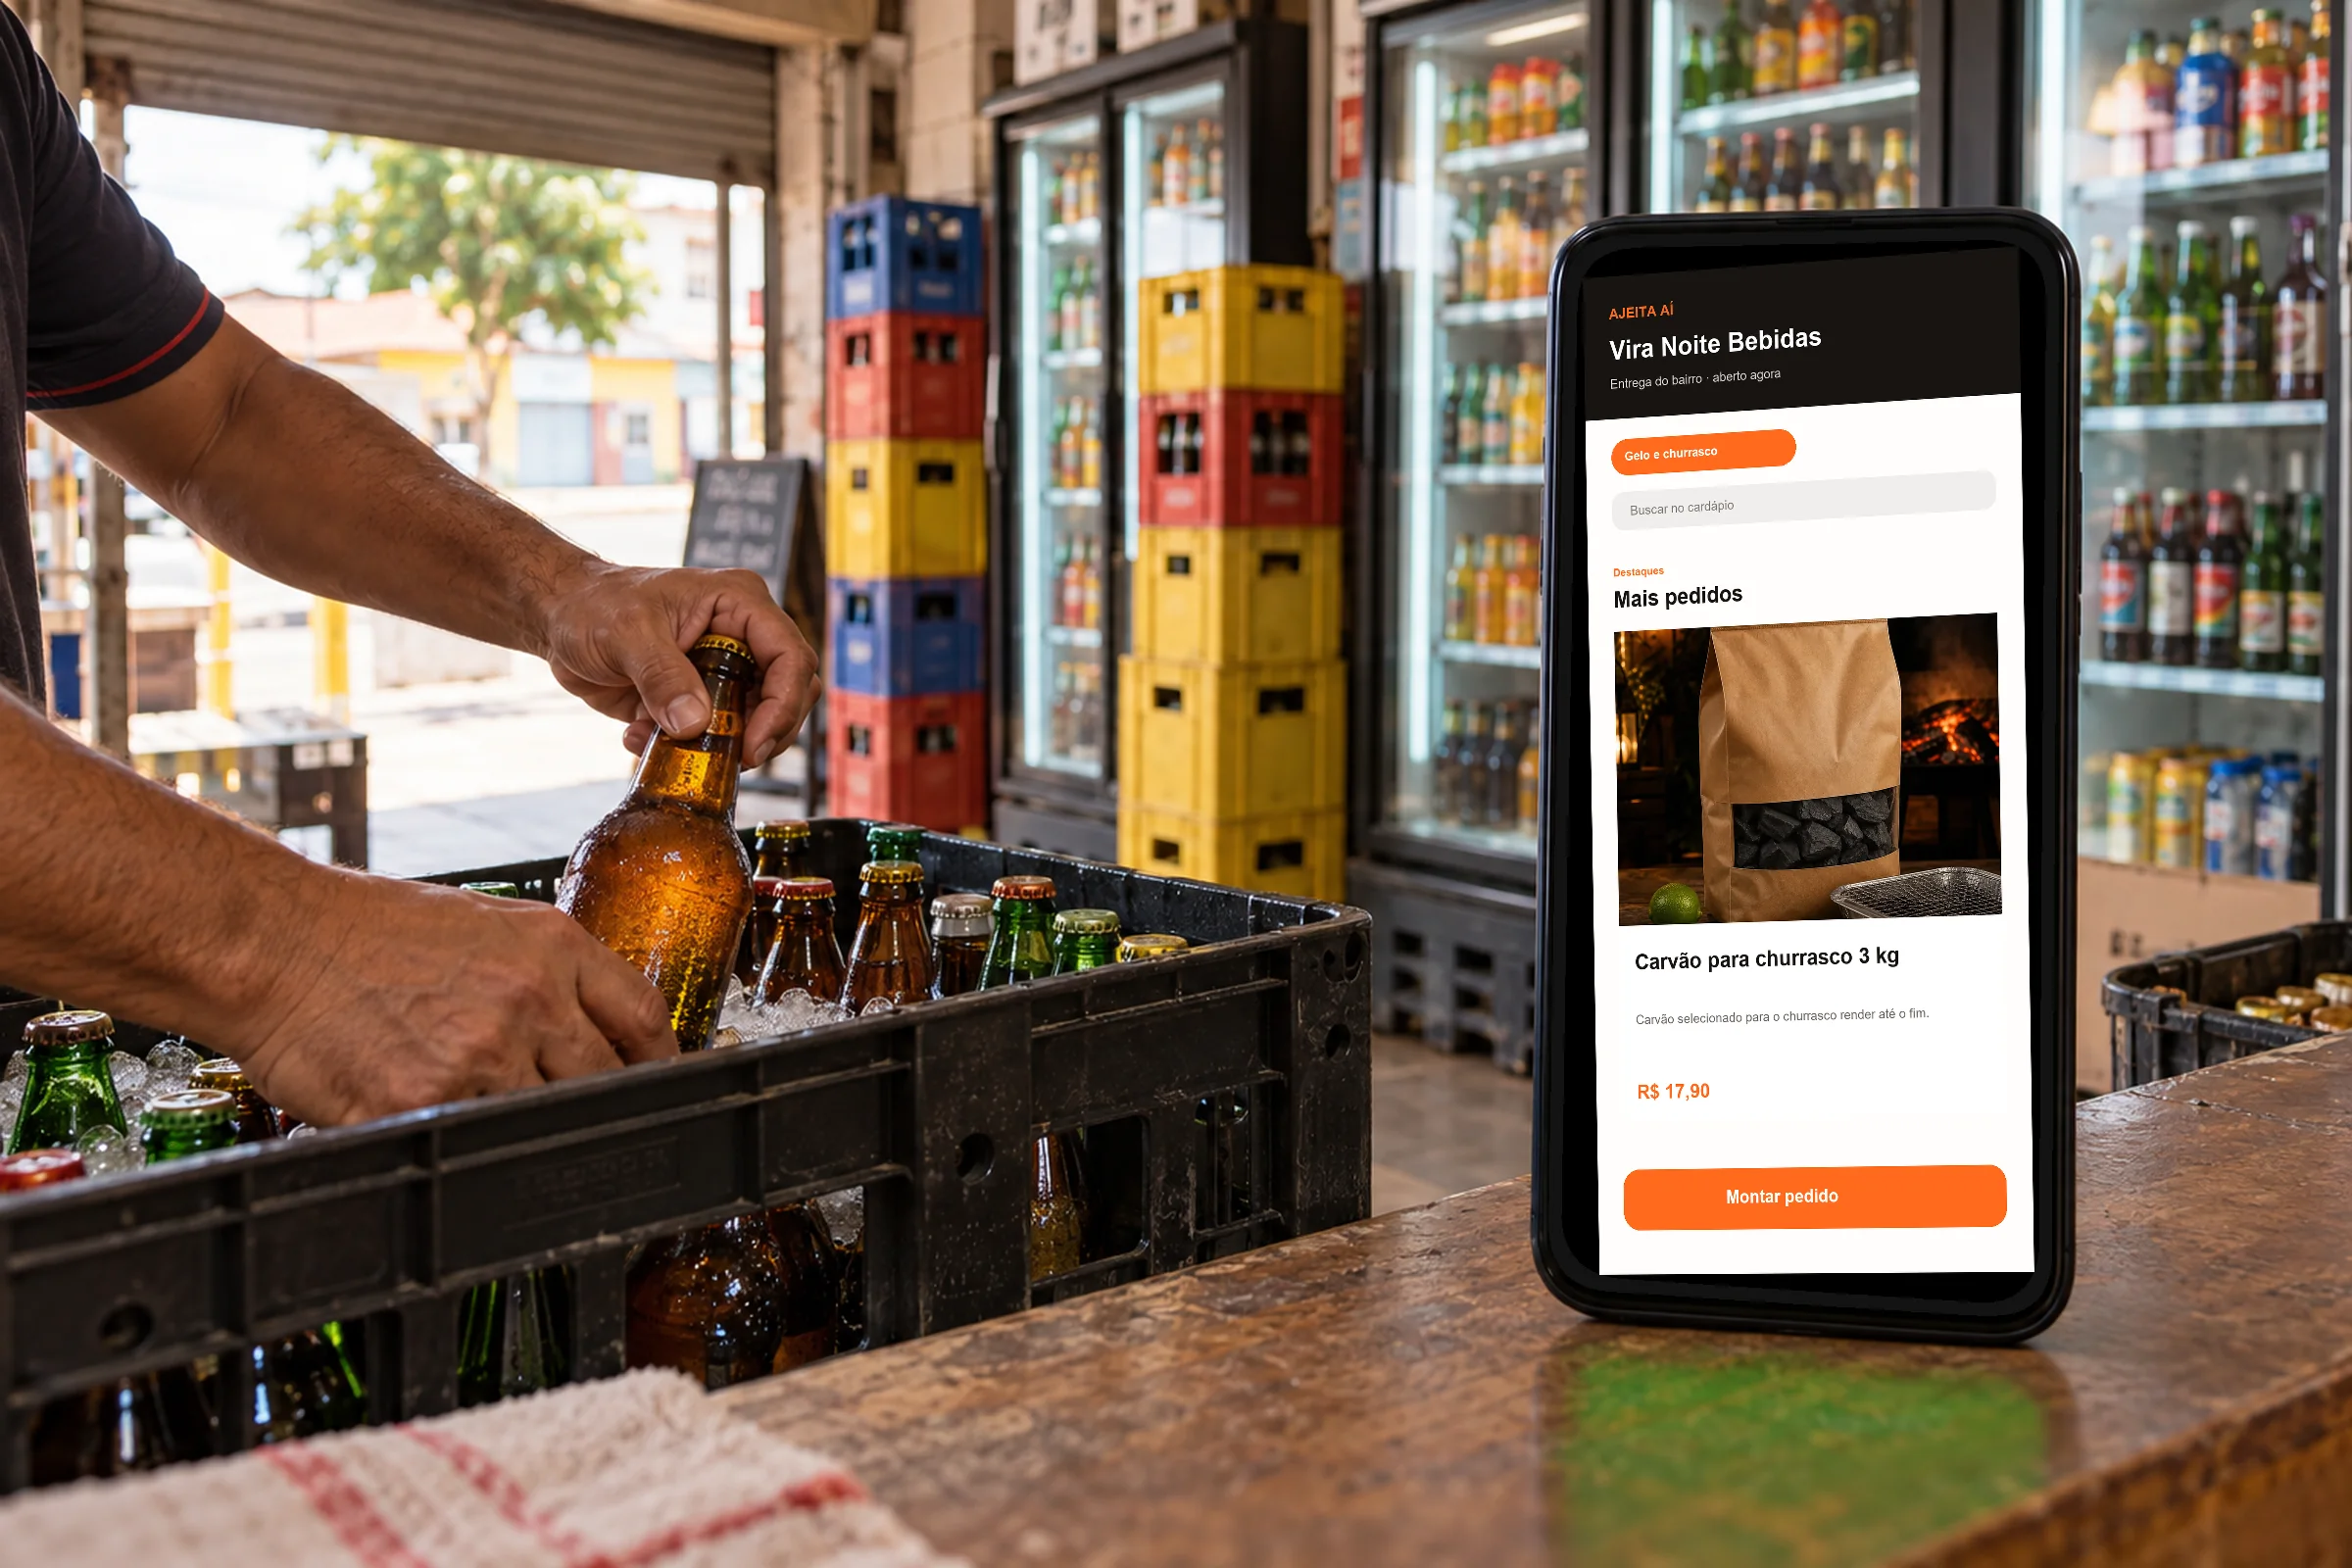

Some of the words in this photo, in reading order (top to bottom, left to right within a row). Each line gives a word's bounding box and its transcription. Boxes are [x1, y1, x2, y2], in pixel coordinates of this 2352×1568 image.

[1608, 305, 1657, 320] AJEITA
[1659, 300, 1674, 317] AÍ
[1608, 338, 1654, 361] Vira
[1661, 334, 1721, 358] Noite
[1728, 327, 1822, 353] Bebidas
[1610, 377, 1652, 390] Entrega
[1654, 375, 1669, 387] do
[1672, 373, 1703, 386] bairro
[1712, 370, 1747, 383] aberto
[1749, 369, 1782, 382] agora
[1624, 450, 1650, 462] Gelo
[1653, 451, 1660, 460] e
[1662, 447, 1718, 460] churrasco
[1630, 505, 1669, 516] Buscar
[1671, 505, 1685, 514] no
[1688, 499, 1735, 514] cardápio
[1613, 567, 1665, 578] Destaques
[1614, 589, 1659, 609] Mais
[1665, 585, 1743, 611] pedidos
[1635, 952, 1702, 970] Carvão
[1708, 954, 1750, 973] para
[1755, 949, 1853, 967] churrasco
[1858, 947, 1870, 964] 3
[1876, 946, 1899, 968] kg
[1636, 1013, 1675, 1025] Carvão
[1677, 1011, 1742, 1024] selecionado
[1745, 1013, 1770, 1025] para
[1773, 1013, 1781, 1022] o
[1783, 1010, 1838, 1022] churrasco
[1839, 1008, 1876, 1020] render
[1878, 1007, 1896, 1019] até
[1898, 1010, 1906, 1019] o
[1909, 1007, 1930, 1019] fim.
[1638, 1082, 1660, 1102] R$
[1665, 1082, 1710, 1102] 17,90
[1726, 1189, 1782, 1204] Montar
[1785, 1188, 1839, 1207] pedido
